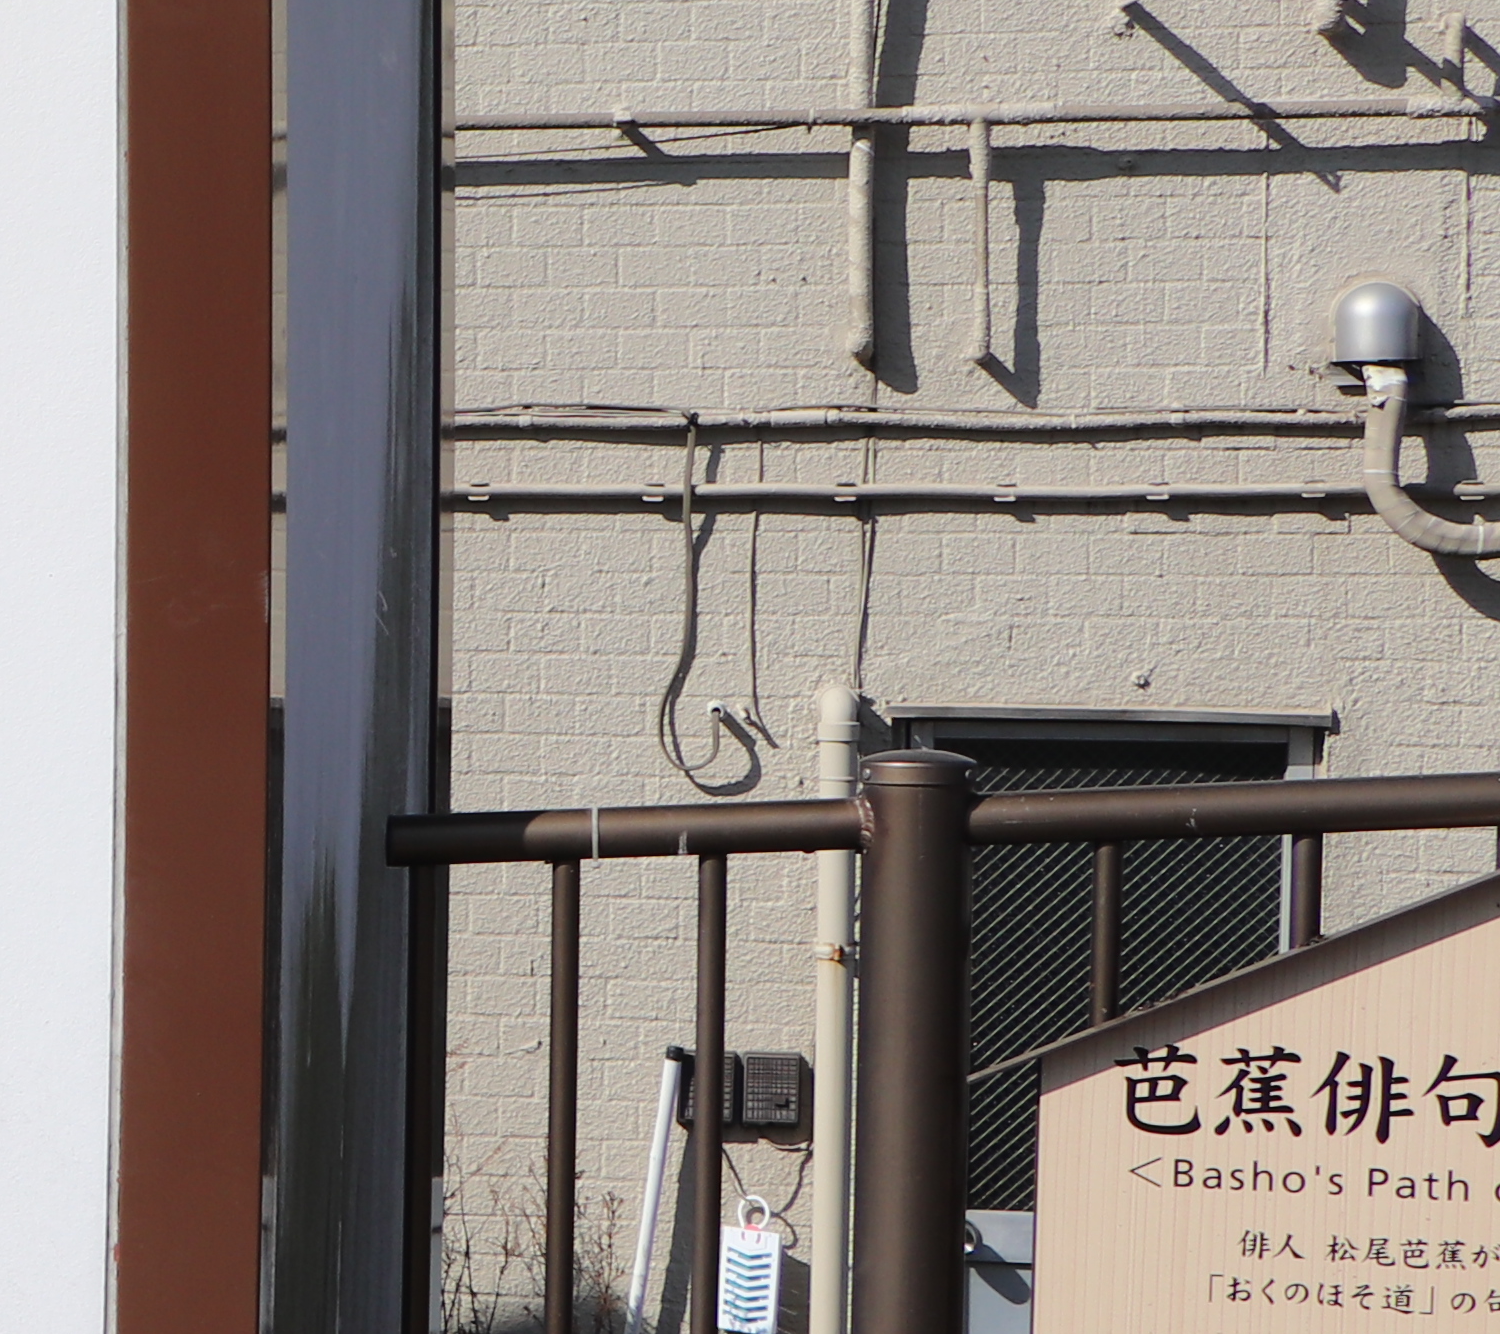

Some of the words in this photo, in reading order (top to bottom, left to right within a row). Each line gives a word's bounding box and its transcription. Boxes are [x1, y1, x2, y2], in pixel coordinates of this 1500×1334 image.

[1113, 1043, 1500, 1149] 芭蕉俳句
[1367, 1168, 1470, 1202] Path
[1238, 1229, 1306, 1260] 俳人
[1326, 1234, 1500, 1270] 松尾芭蕉が
